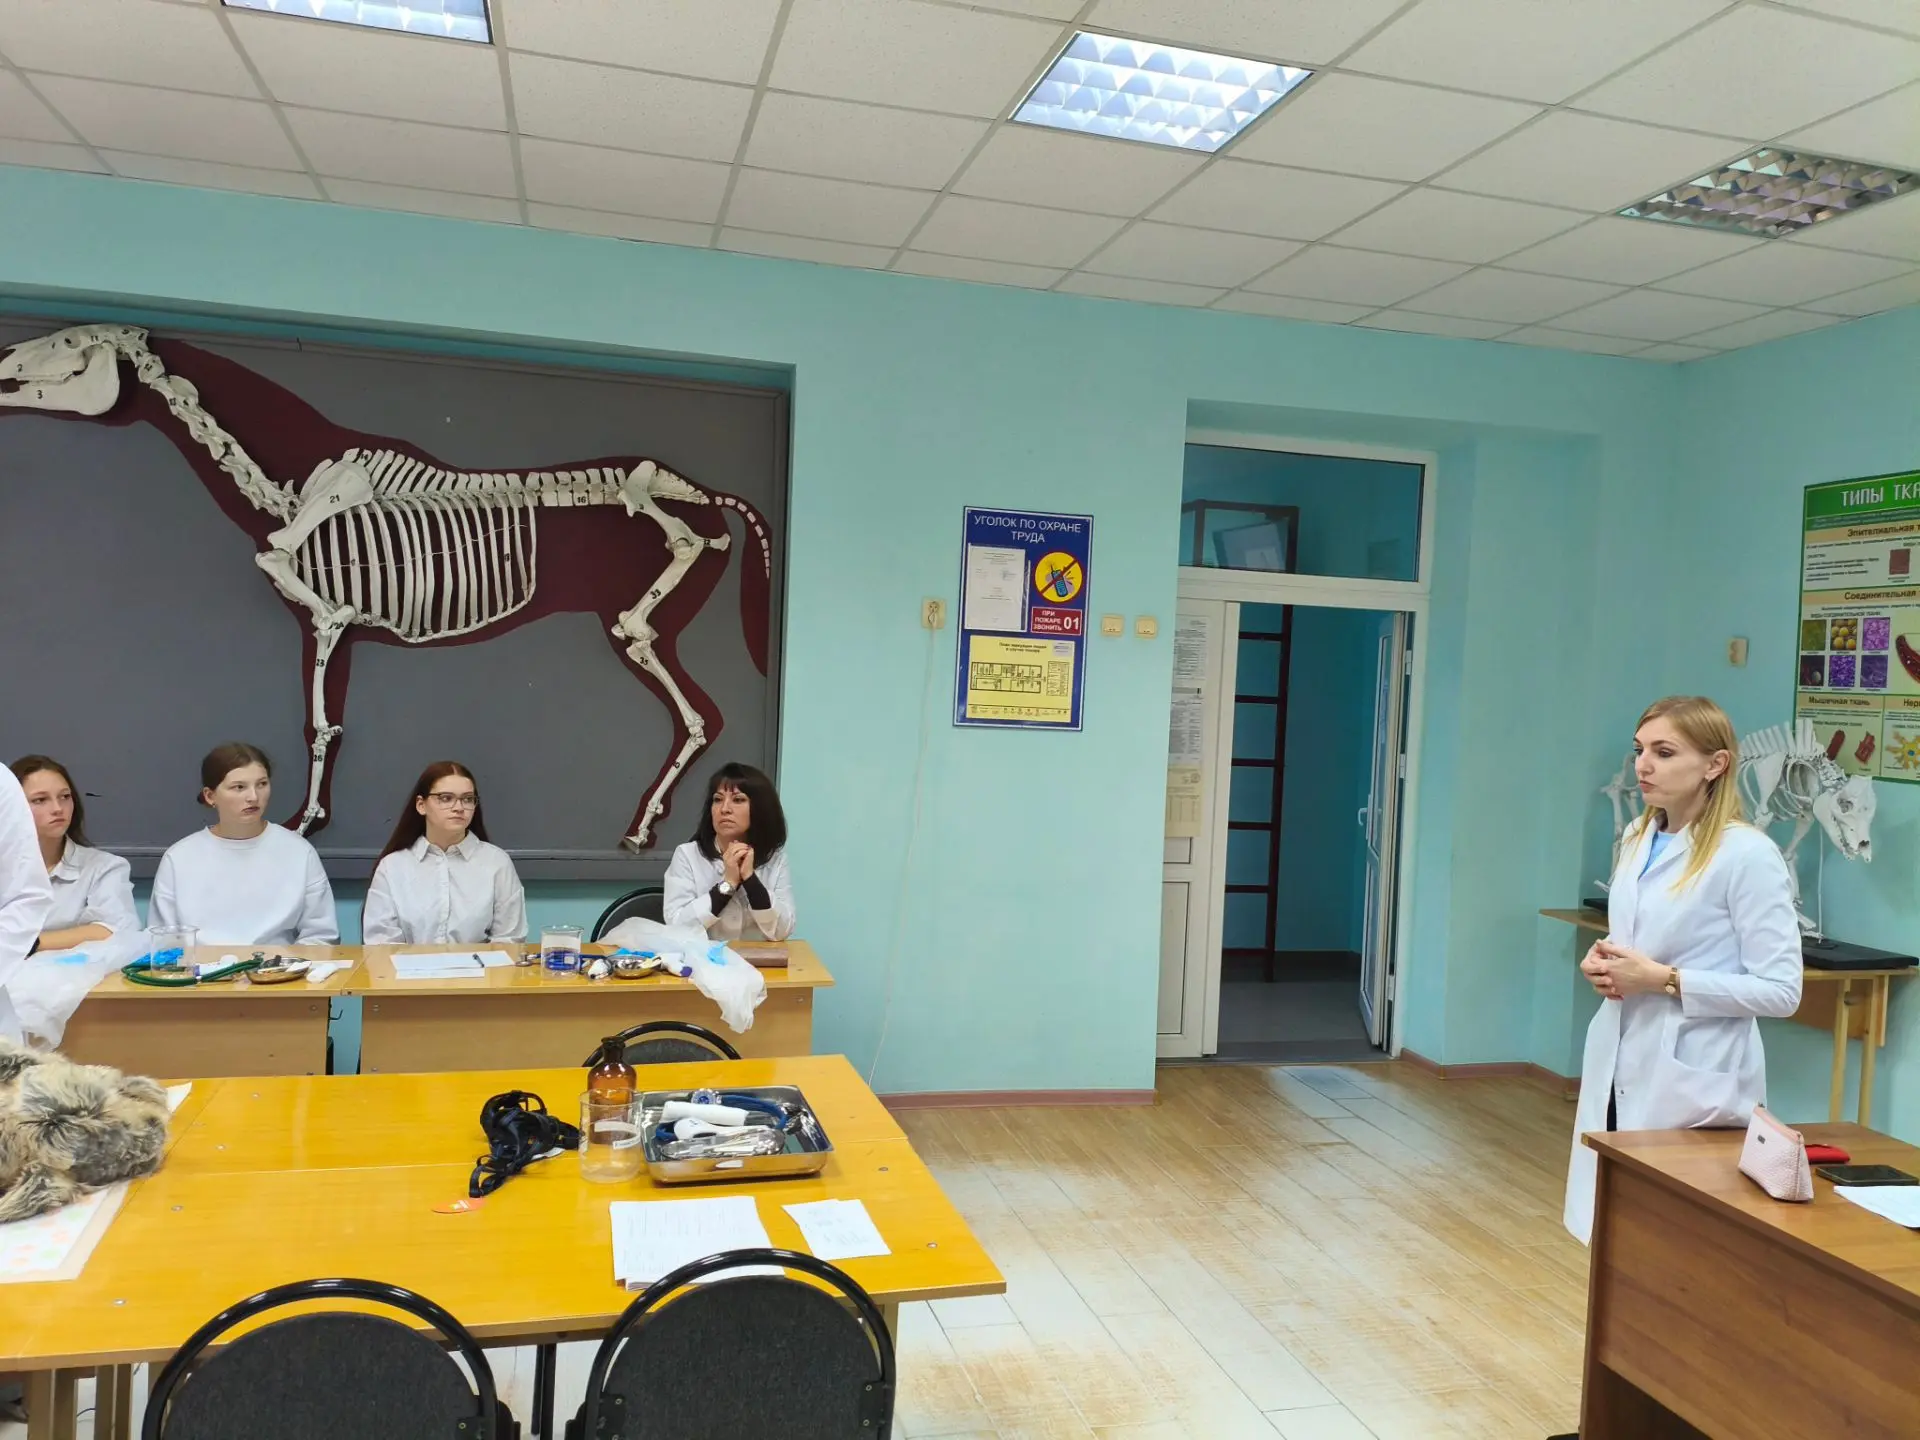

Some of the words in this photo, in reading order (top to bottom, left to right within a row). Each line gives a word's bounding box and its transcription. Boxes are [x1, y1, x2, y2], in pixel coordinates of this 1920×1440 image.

[17, 363, 23, 373] 2
[37, 389, 43, 399] 3
[329, 494, 340, 503] 21
[577, 496, 586, 504] 16
[1841, 486, 1884, 507] ТИПЫ
[974, 515, 1017, 528] УГОЛОК
[1020, 518, 1036, 529] ПО
[1038, 520, 1082, 533] ОХРАНЕ
[1011, 530, 1045, 543] ТРУДА
[1847, 524, 1915, 538] Эпителиальная
[650, 588, 661, 600] 33
[1844, 590, 1917, 601] Соединительная
[1033, 623, 1062, 631] ЗВОНИТЬ
[1063, 616, 1080, 630] 01
[1809, 696, 1848, 704] Мышечная
